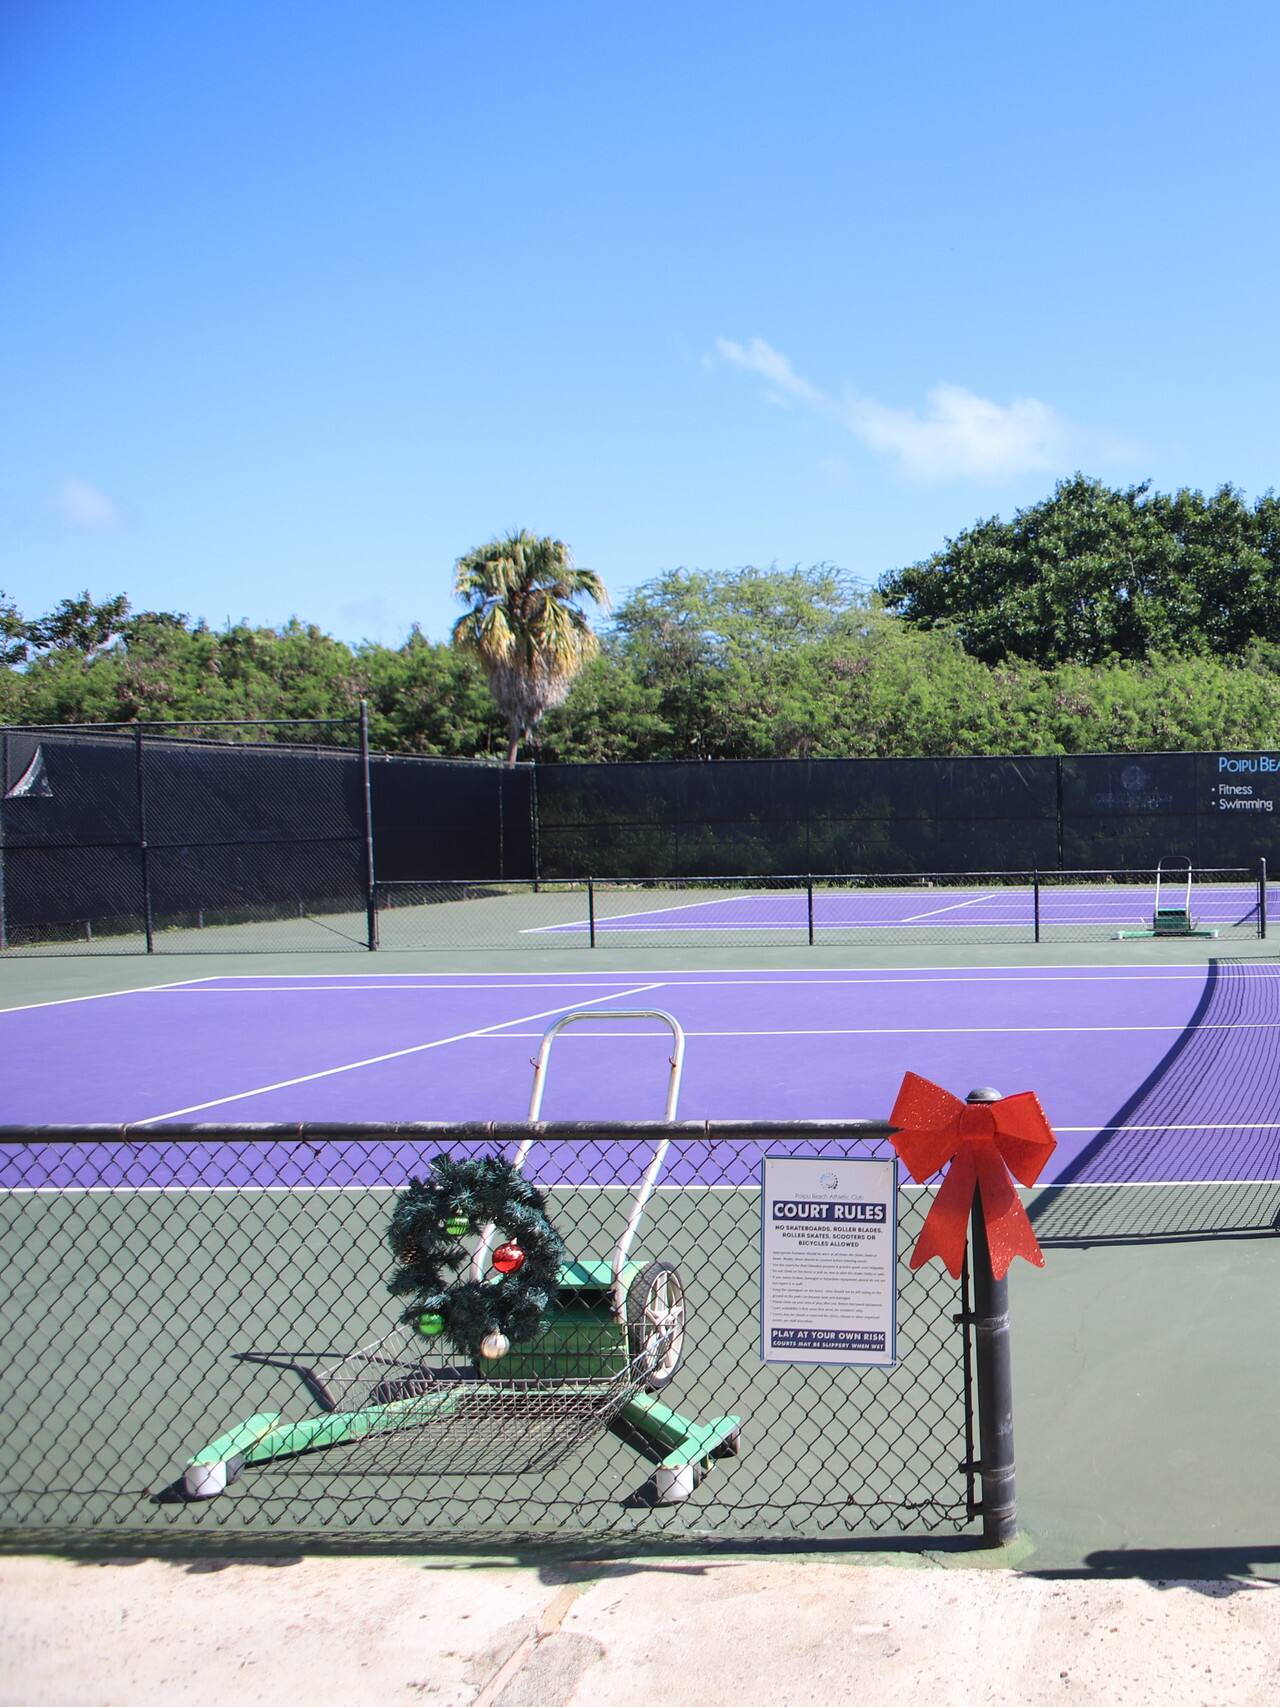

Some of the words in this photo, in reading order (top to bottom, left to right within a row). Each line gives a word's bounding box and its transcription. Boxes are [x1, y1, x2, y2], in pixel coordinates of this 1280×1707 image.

[1218, 756, 1257, 773] POIPU
[1218, 784, 1253, 795] Fitness
[1219, 798, 1273, 811] Swimming
[774, 1203, 829, 1219] COURT
[834, 1204, 883, 1220] RULES
[772, 1330, 794, 1338] PLAY
[811, 1331, 836, 1339] YOUR
[838, 1332, 862, 1340] OWN
[864, 1333, 885, 1341] RISK
